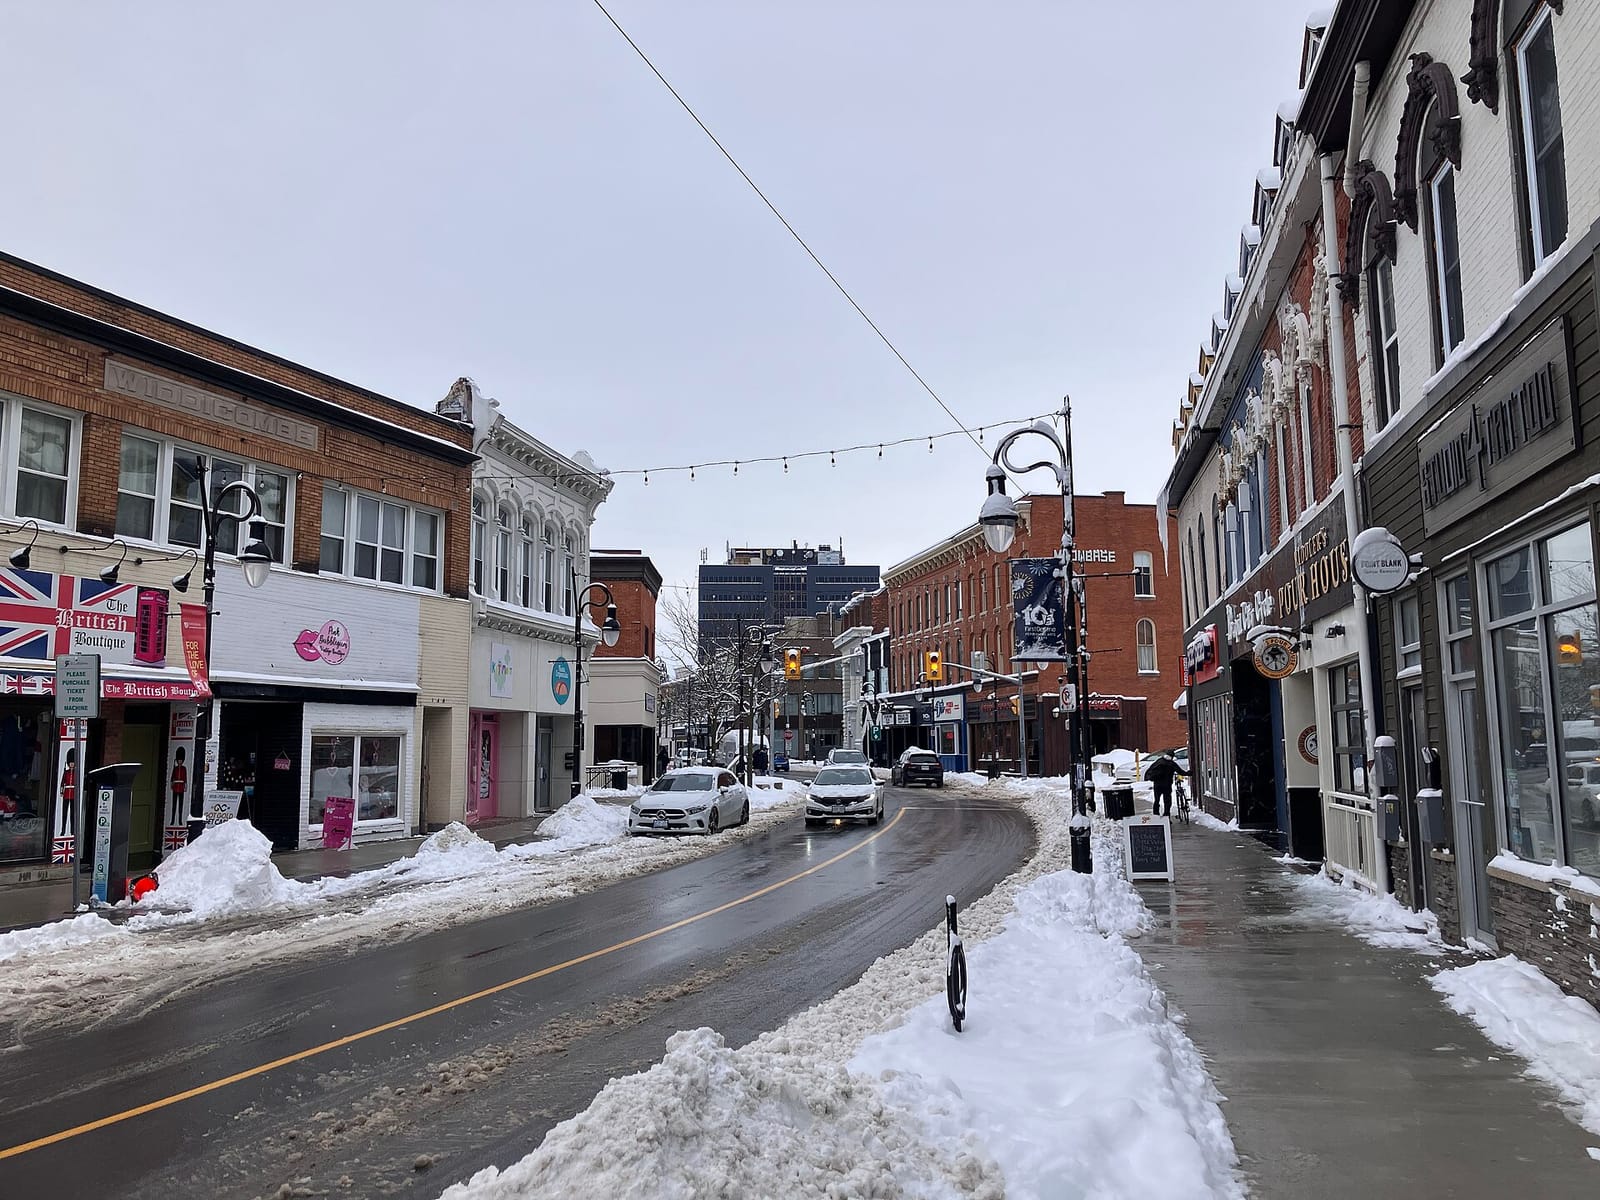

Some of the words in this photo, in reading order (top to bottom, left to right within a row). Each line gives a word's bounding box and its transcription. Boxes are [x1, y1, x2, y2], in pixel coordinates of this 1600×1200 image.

[1421, 431, 1469, 511] STUDIO
[1381, 559, 1402, 568] BLANK
[1278, 572, 1309, 619] POUR
[1310, 538, 1349, 601] HOUS
[106, 598, 129, 613] The
[56, 608, 127, 632] British
[328, 625, 340, 636] Pink
[75, 631, 126, 650] Boutique
[185, 641, 199, 650] FOR
[319, 634, 348, 650] Bubblegum
[186, 650, 199, 660] THE
[190, 660, 205, 669] LOVE
[105, 684, 121, 693] The
[123, 682, 168, 698] British
